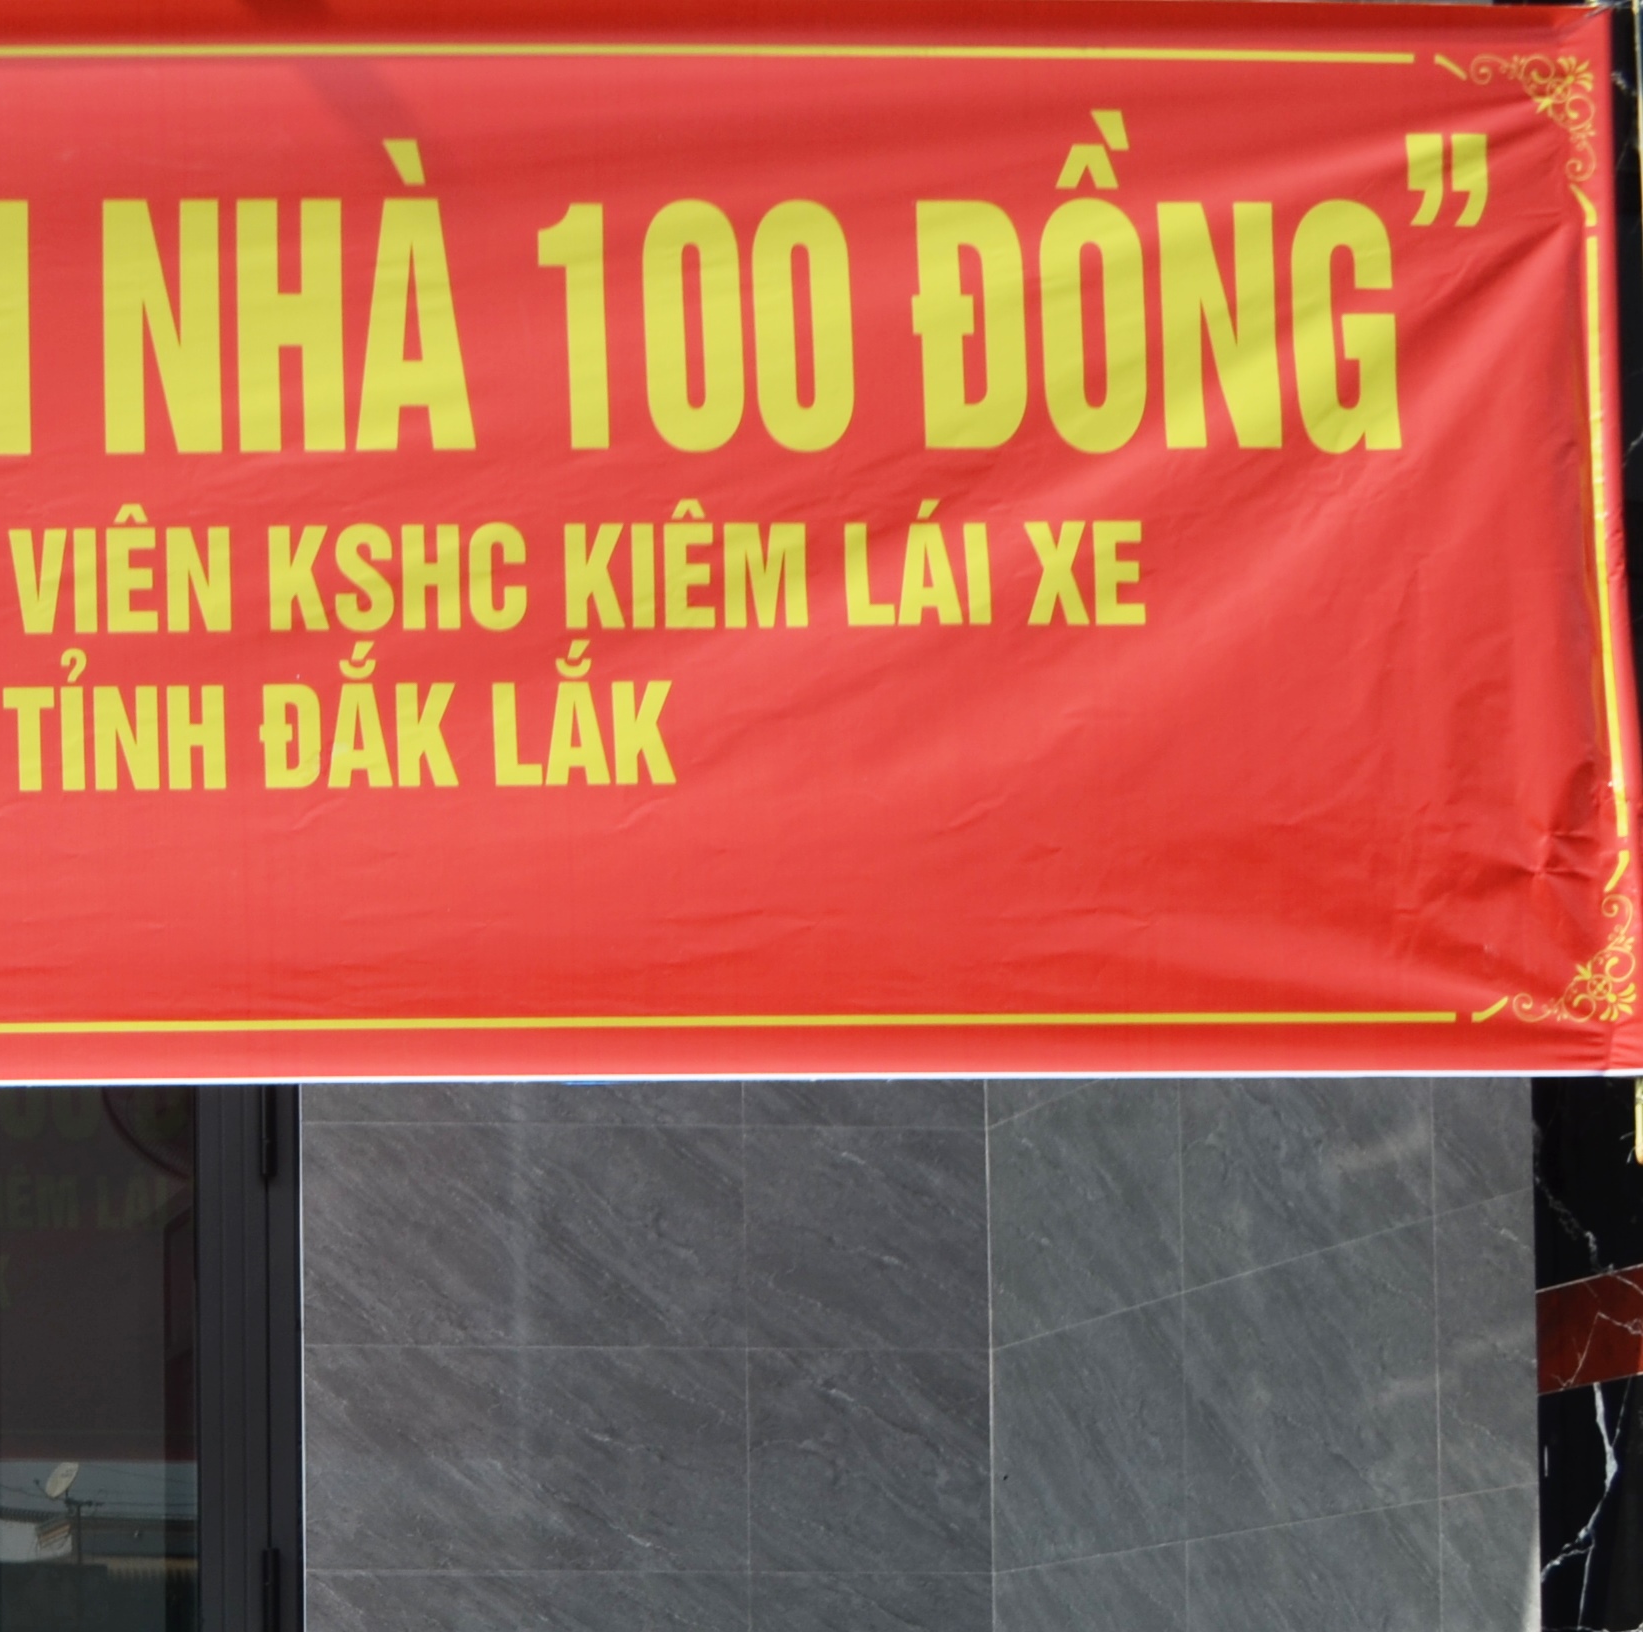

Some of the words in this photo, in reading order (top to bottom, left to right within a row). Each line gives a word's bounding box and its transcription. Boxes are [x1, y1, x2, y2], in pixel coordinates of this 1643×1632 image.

[104, 140, 475, 453] NHÀ
[539, 200, 854, 451] 100
[10, 505, 231, 633] VIÊN
[269, 523, 527, 631] KSHC
[565, 500, 808, 628] KIÊM
[845, 500, 991, 625] LÁI
[1026, 521, 1146, 624] XE
[3, 649, 226, 791] TỈNH
[260, 642, 458, 788] ĐẮK
[493, 640, 675, 785] LẮK
